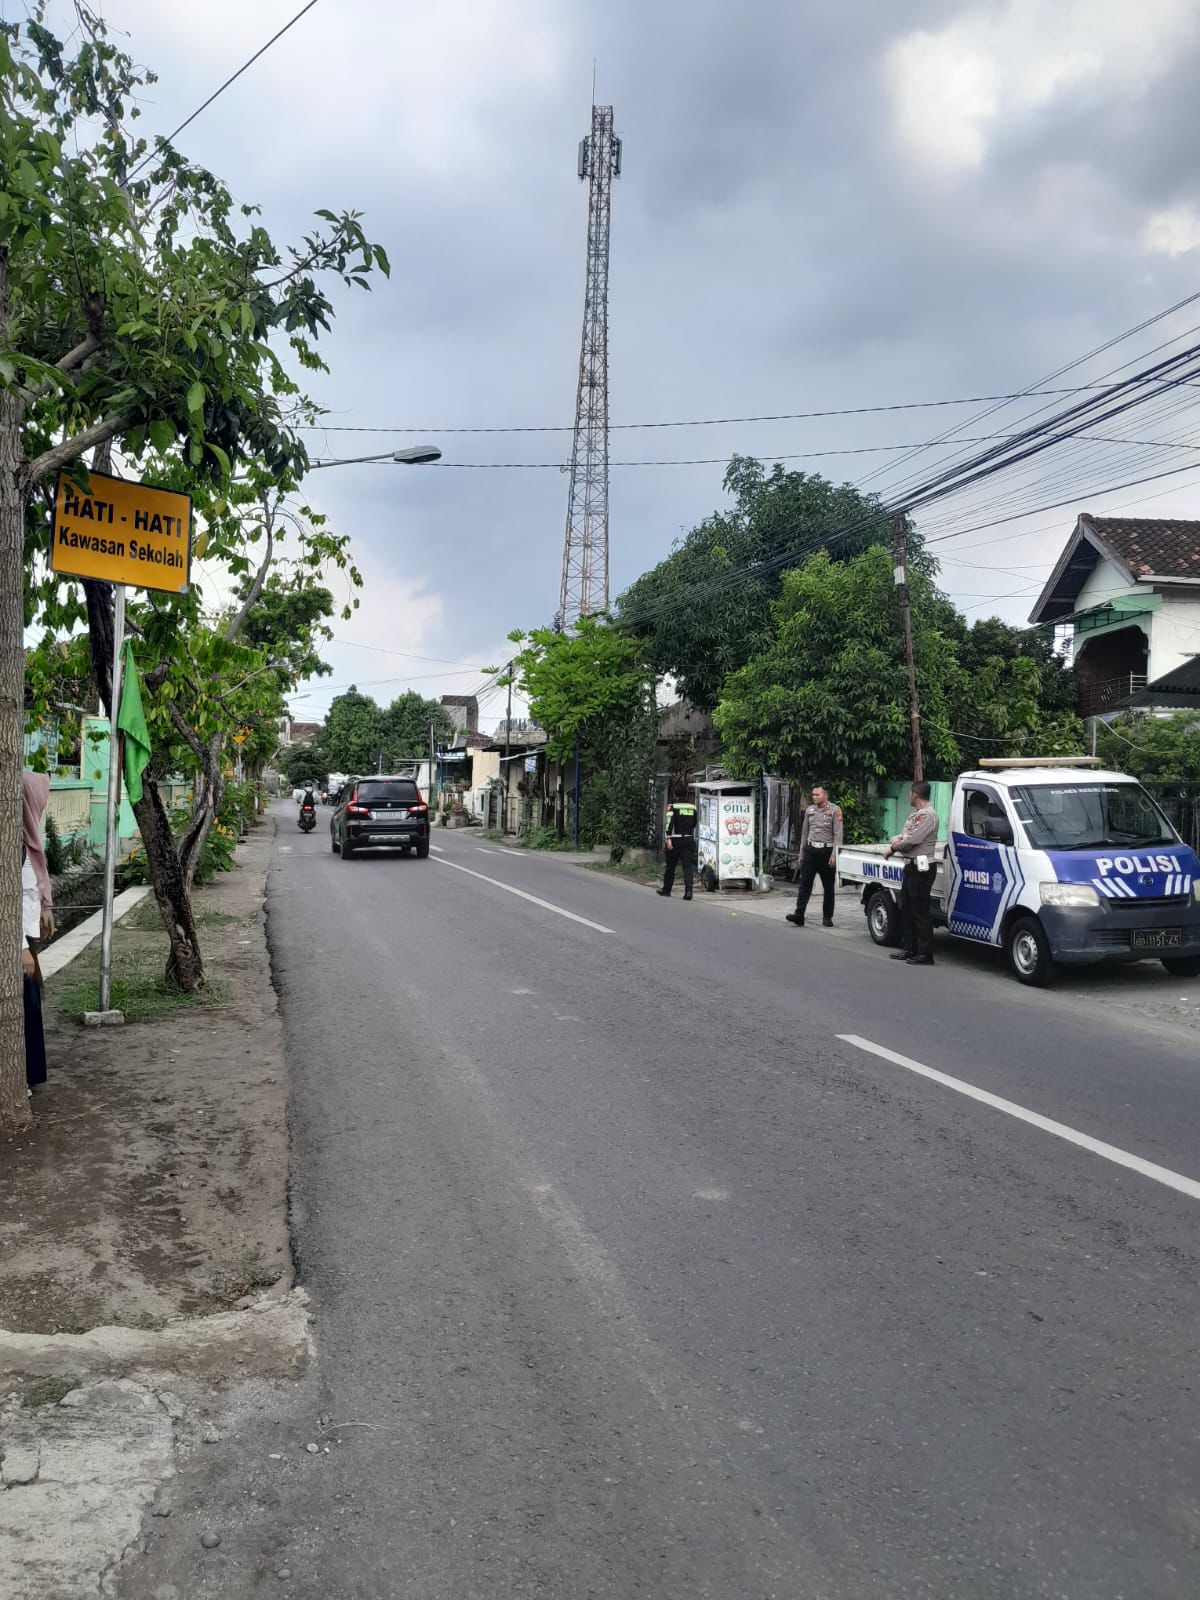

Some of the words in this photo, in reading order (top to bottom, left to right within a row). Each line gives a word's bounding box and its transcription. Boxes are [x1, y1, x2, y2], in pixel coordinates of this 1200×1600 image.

[63, 493, 114, 524] HATI
[134, 509, 182, 538] HATI
[58, 525, 125, 557] Kawasan
[129, 539, 184, 569] Sekolah
[862, 862, 880, 878] UNIT
[1095, 855, 1182, 876] POLISI
[963, 869, 990, 885] POLISI
